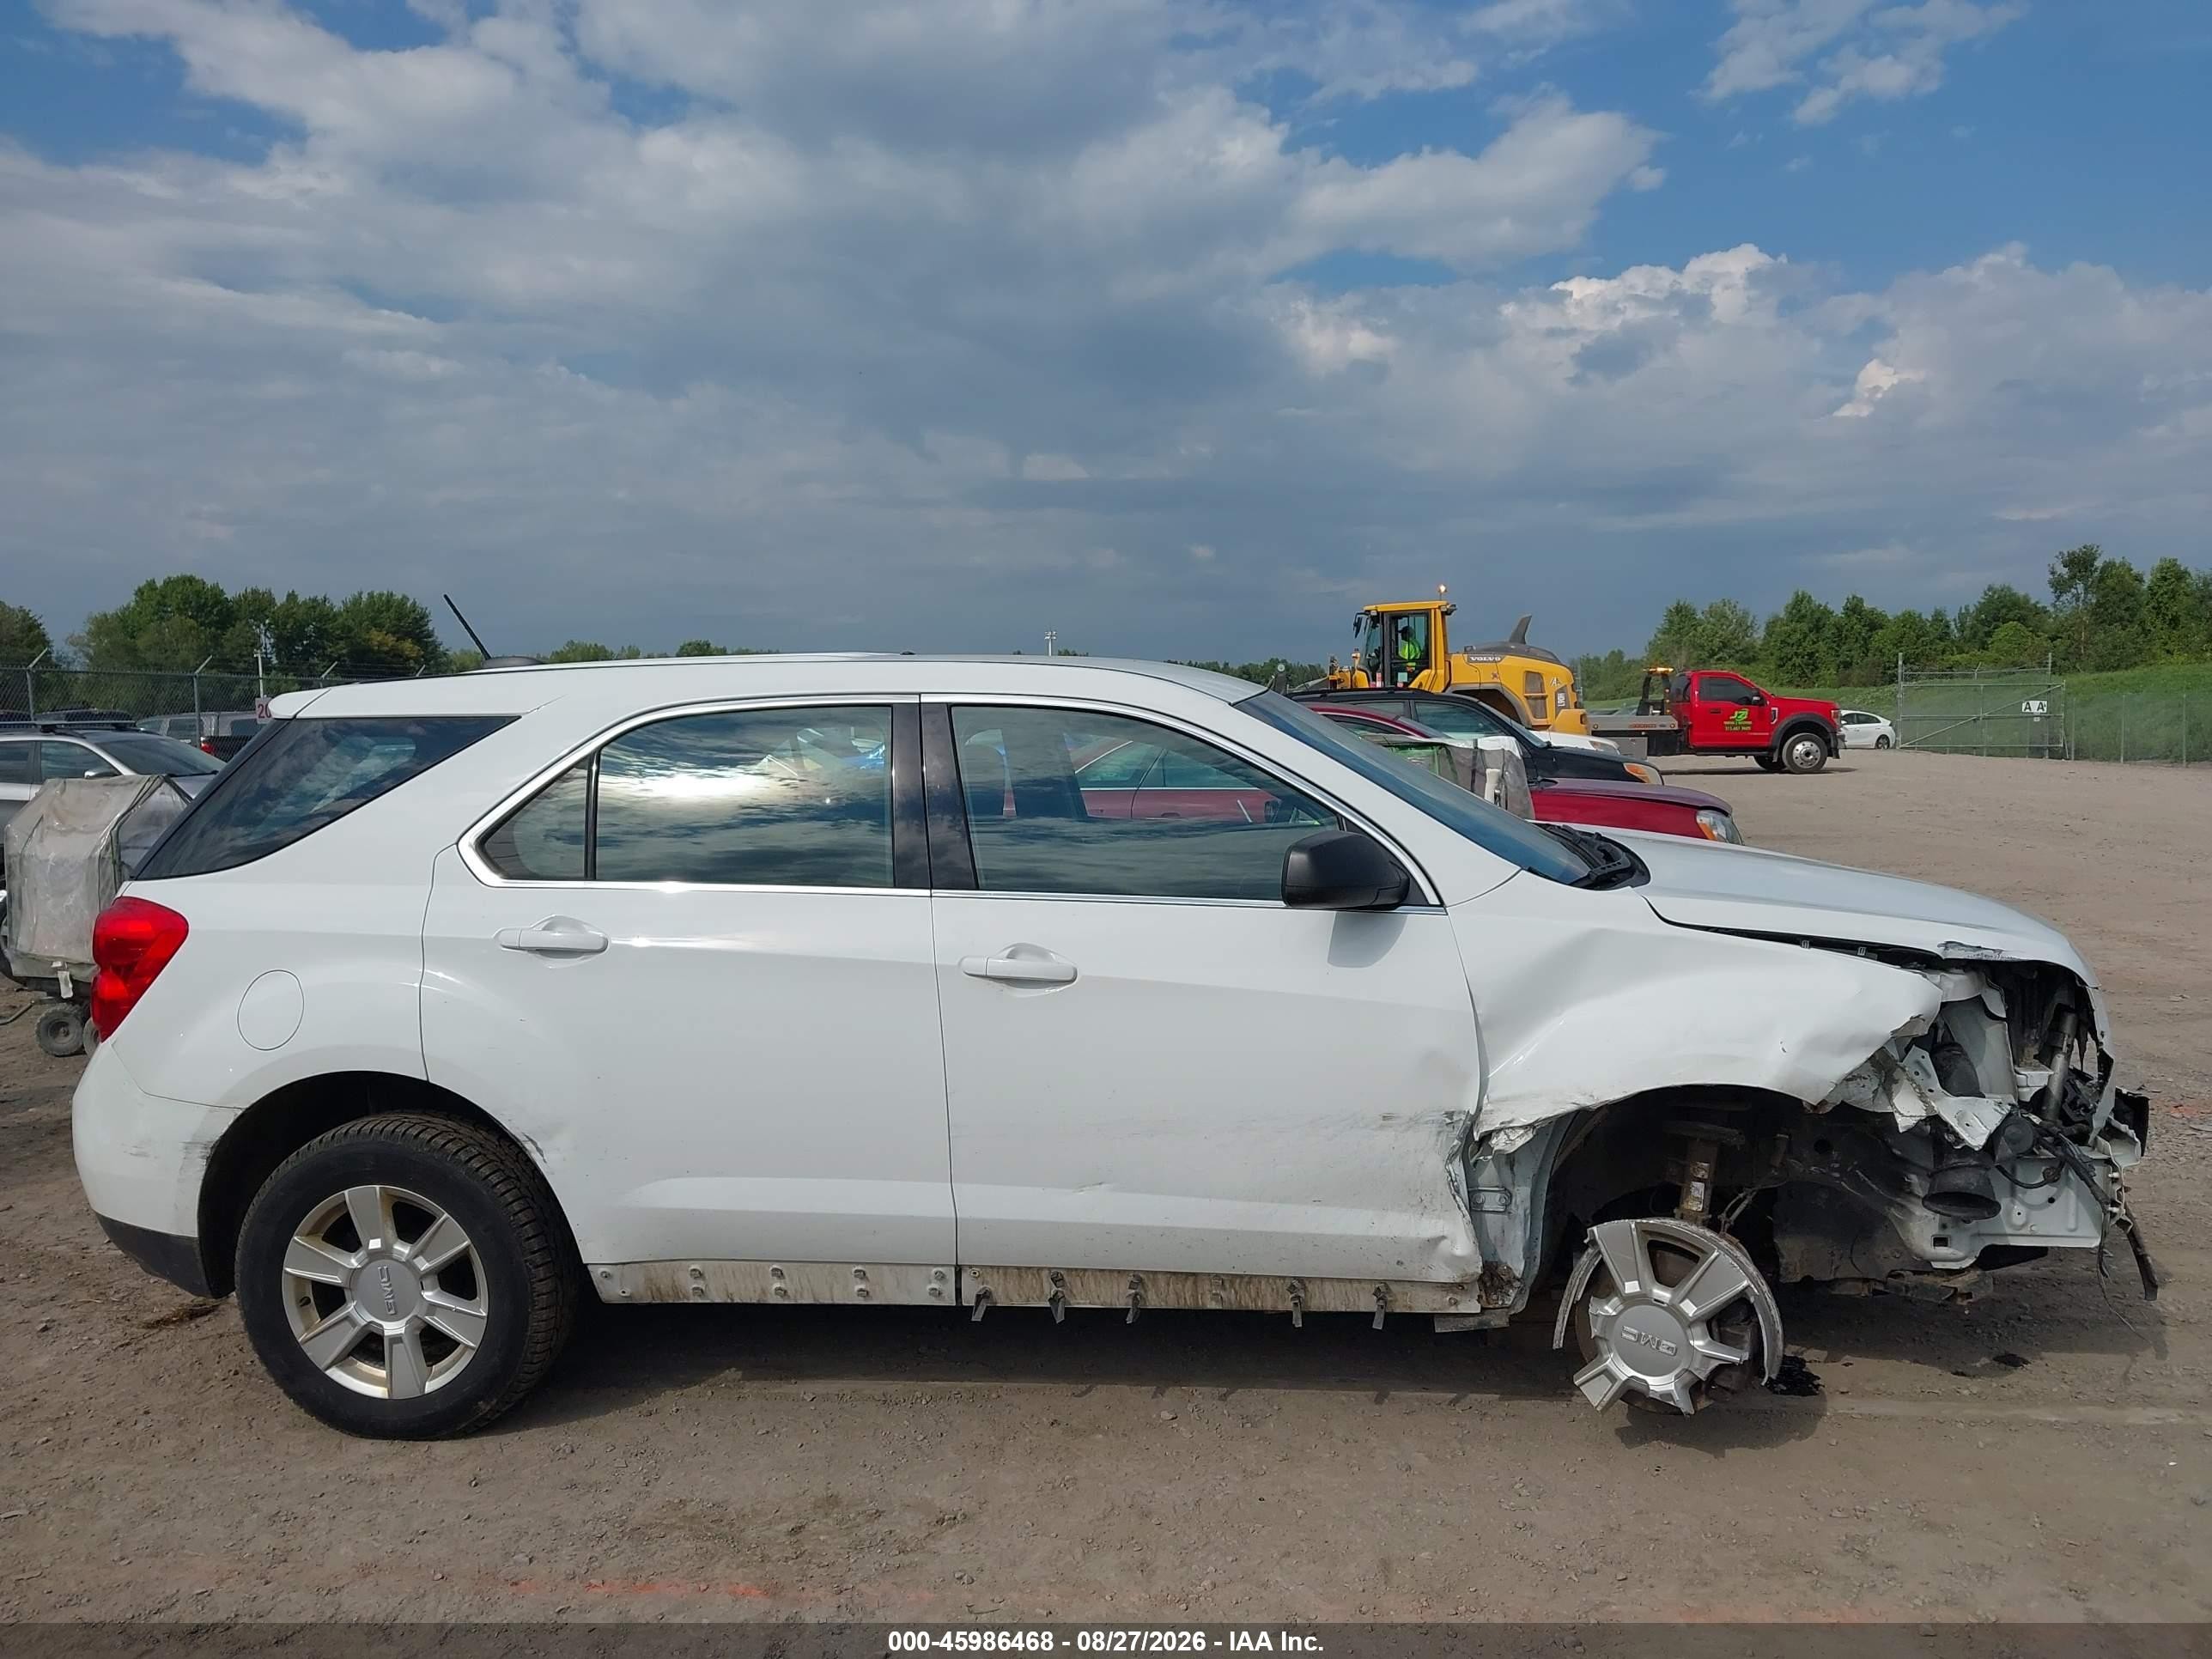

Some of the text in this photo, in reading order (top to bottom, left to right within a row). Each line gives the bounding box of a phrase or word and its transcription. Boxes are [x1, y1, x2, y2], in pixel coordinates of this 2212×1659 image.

[2023, 701, 2045, 712] A A
[378, 1264, 396, 1315] GMC
[1620, 1325, 1677, 1357] GMC
